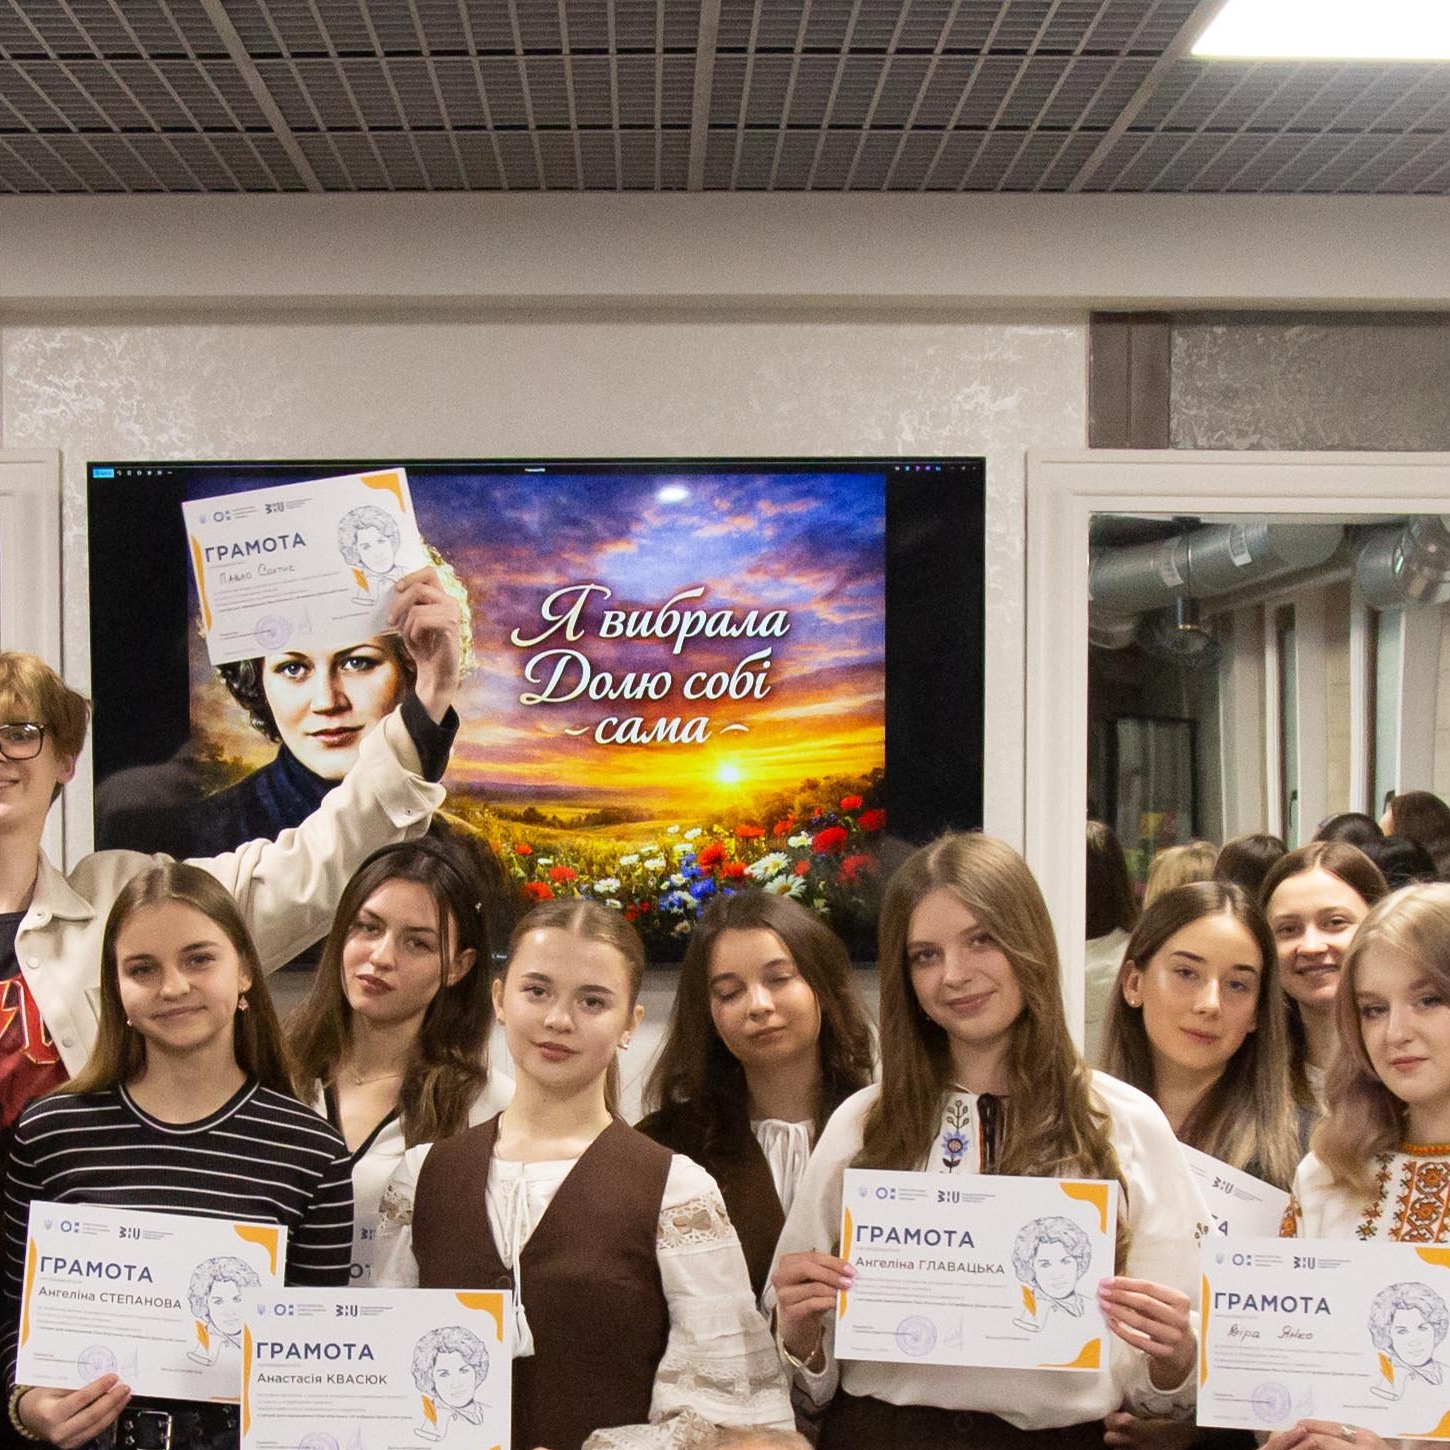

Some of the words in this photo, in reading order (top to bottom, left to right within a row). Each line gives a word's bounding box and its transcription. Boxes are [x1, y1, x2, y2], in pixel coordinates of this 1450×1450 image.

[205, 532, 306, 562] ГРАМОТА
[510, 583, 612, 647] Я
[599, 586, 790, 654] вибрала
[519, 648, 671, 705] Долю
[683, 647, 772, 699] собі
[595, 716, 712, 744] сама
[856, 1225, 975, 1249] ГРАМОТА
[40, 1256, 153, 1283] ГРАМОТА
[855, 1257, 915, 1271] Ангеліна
[919, 1261, 1005, 1275] ГЛАВАЦЬКА
[38, 1286, 95, 1302] Ангеліна
[100, 1293, 182, 1310] СТЕПАНОВА
[1214, 1292, 1332, 1315] ГРАМОТА
[256, 1342, 374, 1360] ГРАМОТА
[257, 1373, 322, 1385] Анастасія
[327, 1374, 388, 1385] КВАСЮК
